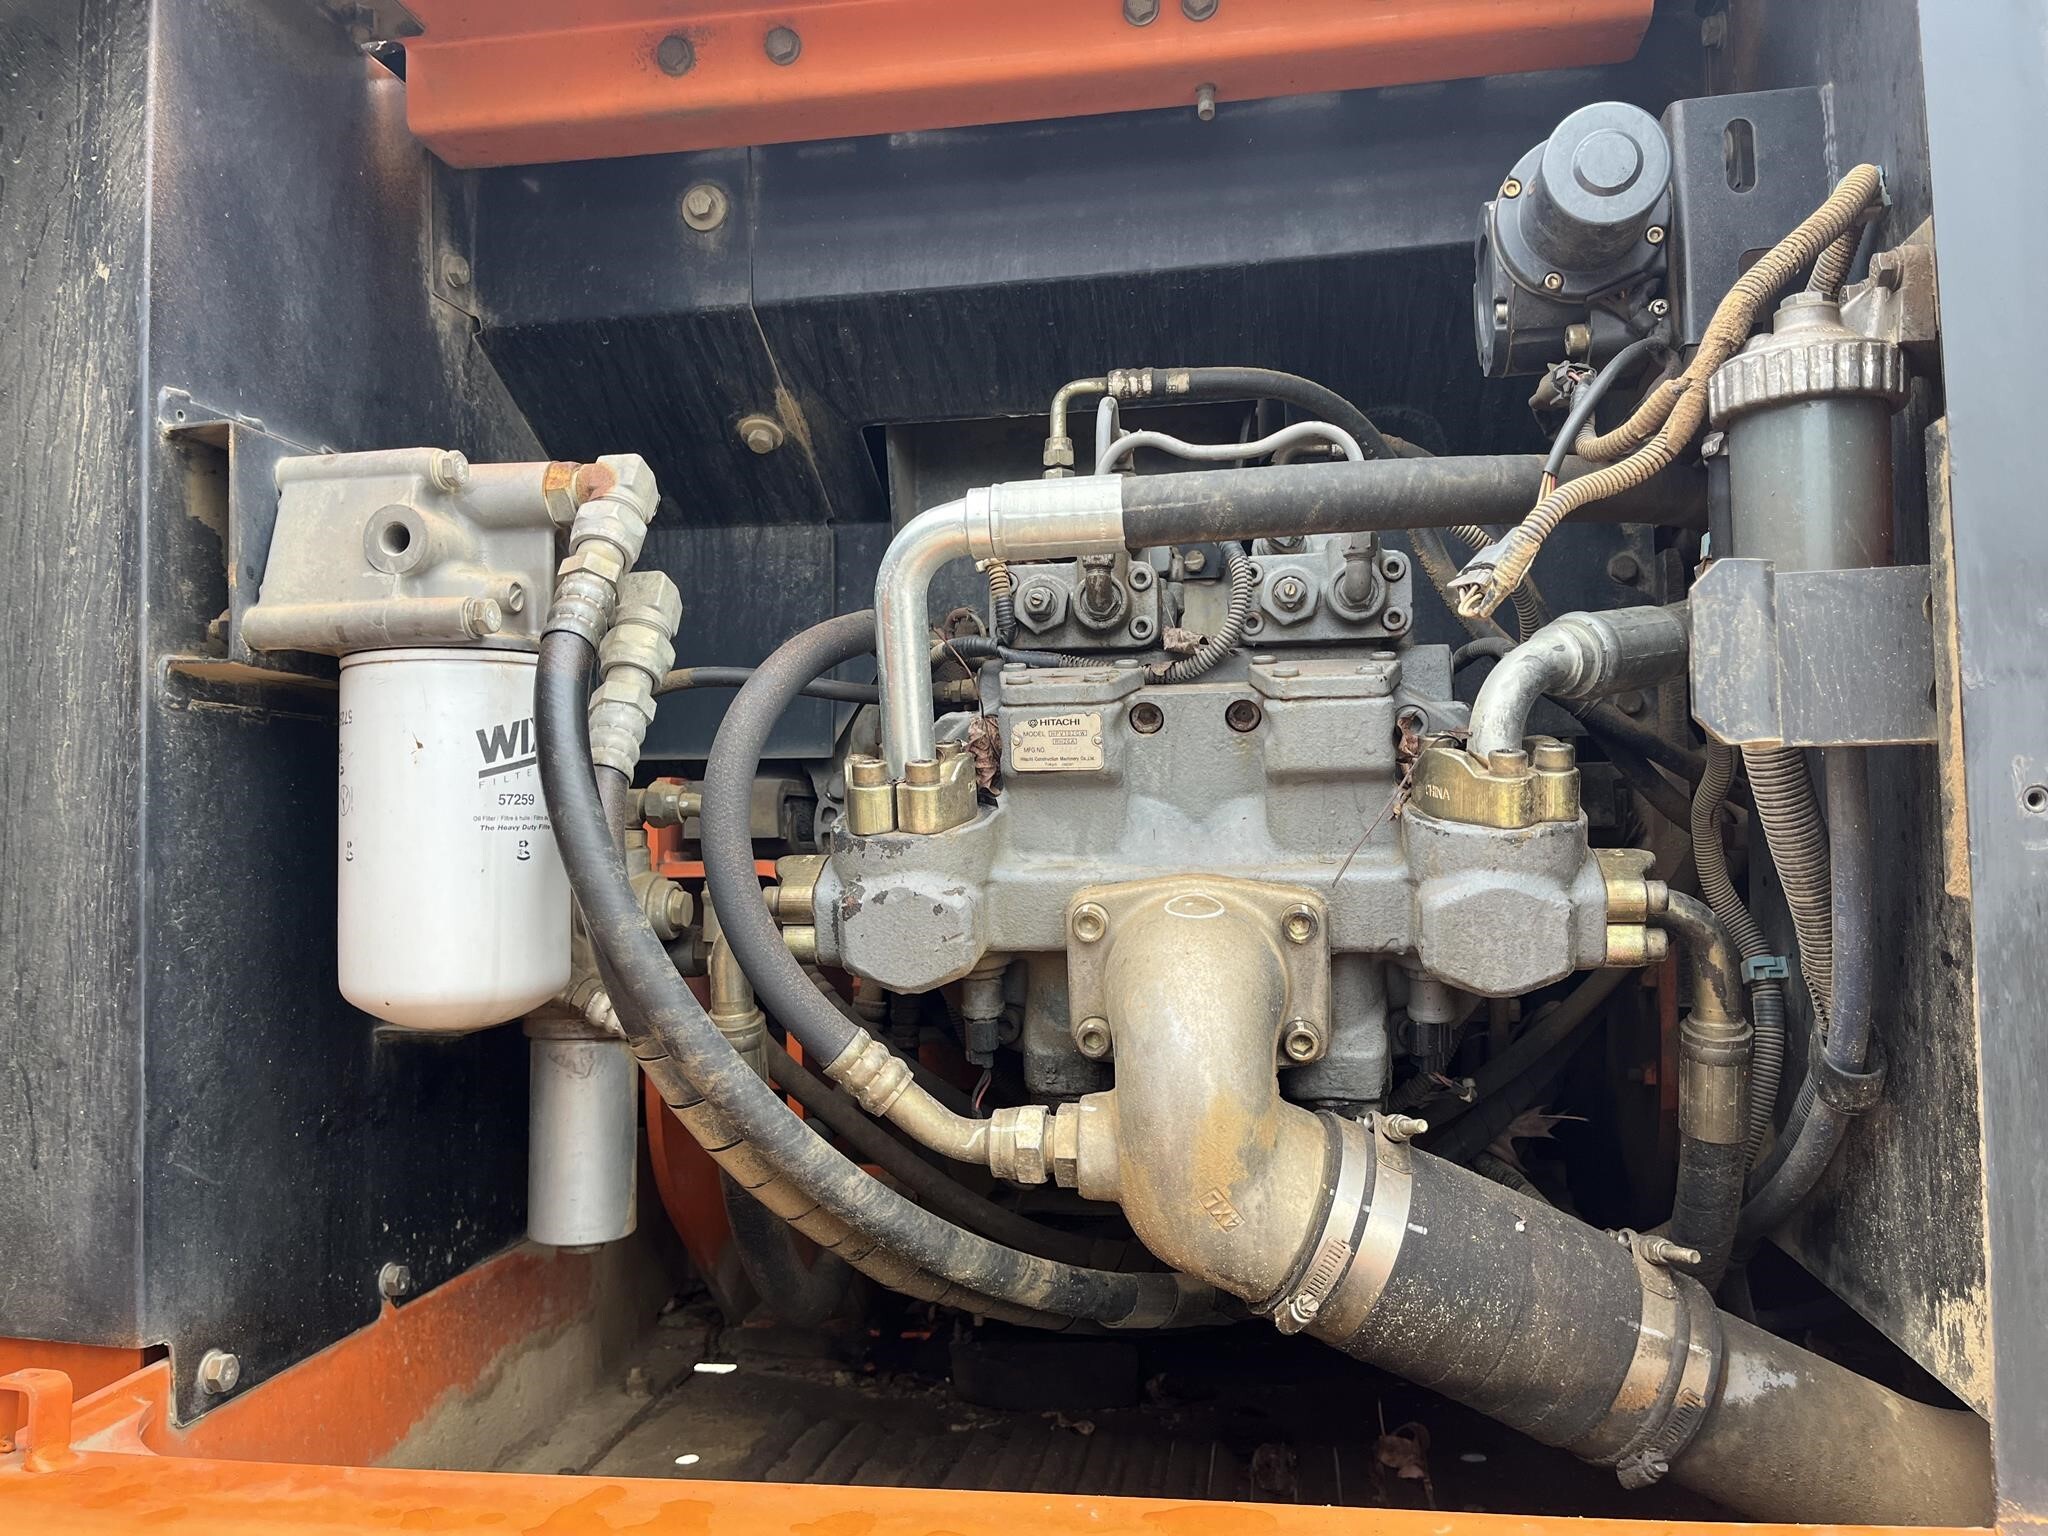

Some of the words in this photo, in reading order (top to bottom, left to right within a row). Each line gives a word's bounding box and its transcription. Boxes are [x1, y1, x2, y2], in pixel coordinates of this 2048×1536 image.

[1040, 718, 1080, 726] HITACHI
[478, 768, 533, 790] FILTE
[498, 793, 535, 806] 57259
[480, 824, 495, 832] The
[497, 824, 520, 832] Heavy
[522, 823, 537, 832] Duty
